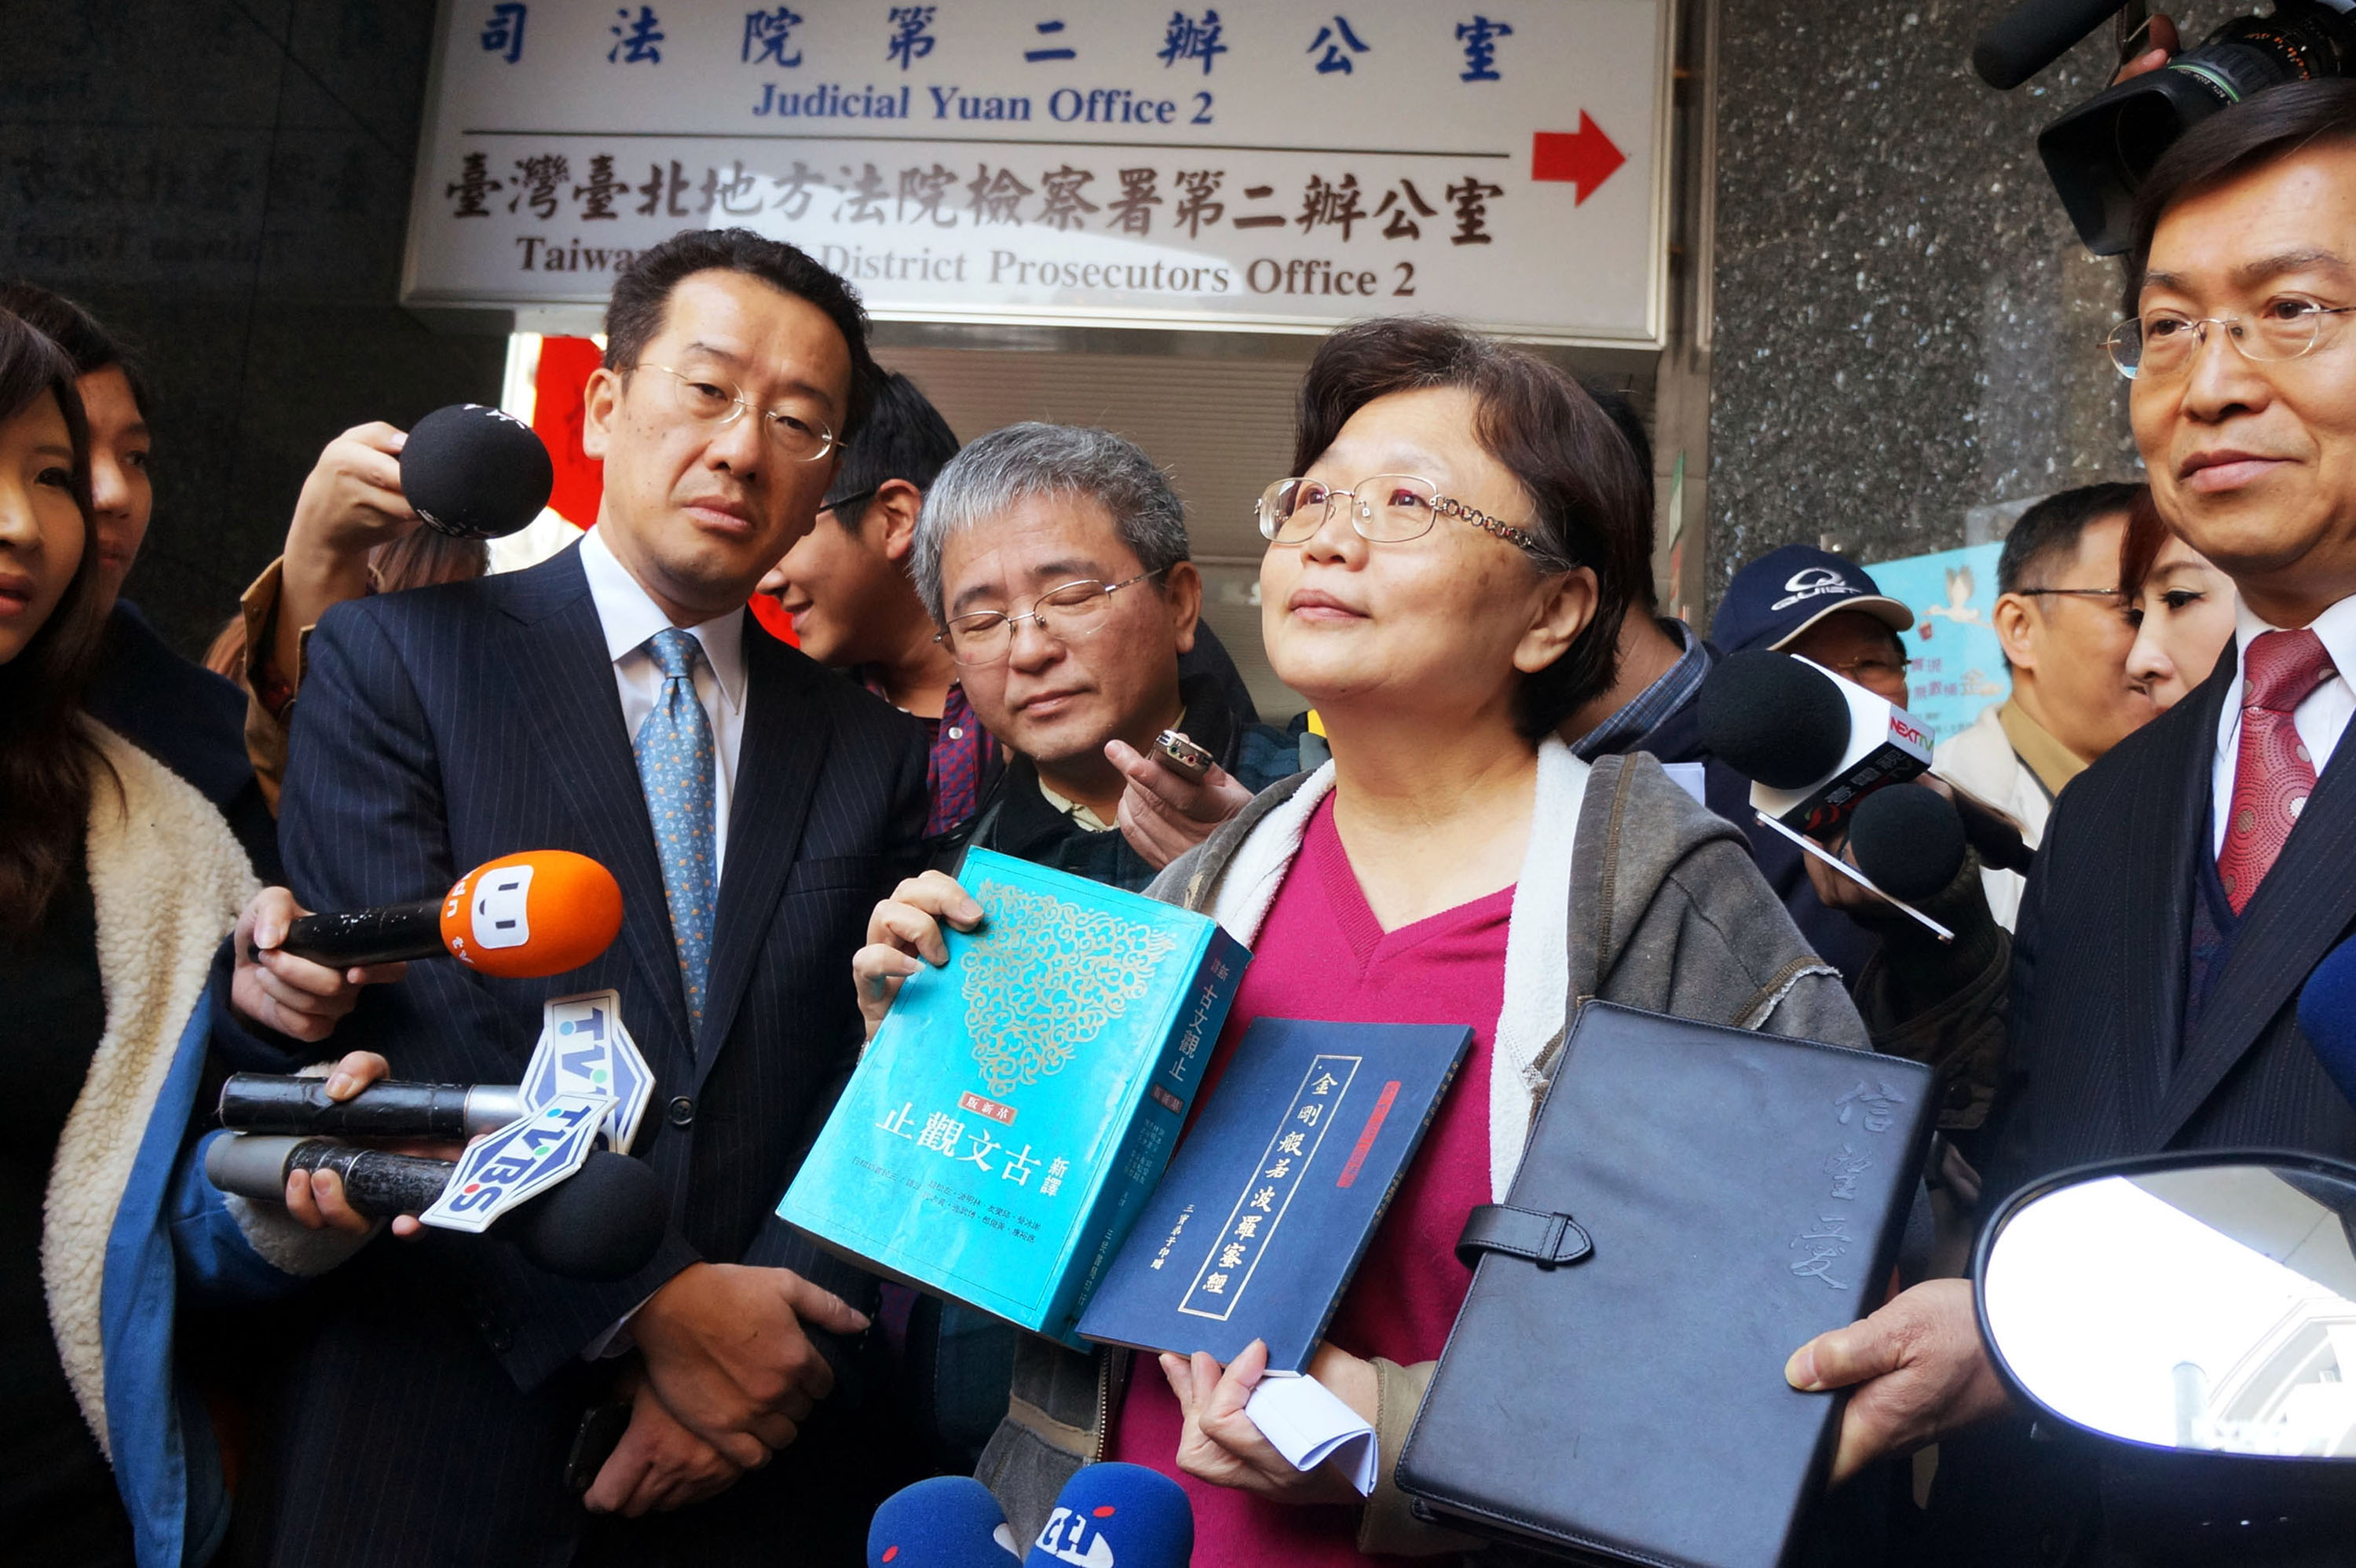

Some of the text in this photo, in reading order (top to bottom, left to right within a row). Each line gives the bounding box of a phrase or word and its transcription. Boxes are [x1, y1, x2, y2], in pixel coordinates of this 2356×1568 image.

[480, 2, 1513, 83] 司法院第二辦公室
[752, 82, 1213, 126] Judicial Yuan Office 2
[446, 153, 1504, 246] 臺灣臺北地方法院檢察署第二辦公室
[515, 237, 1417, 297] Taiwa District Prosecutors Office 2
[1169, 984, 1218, 1082] 古文觀止
[874, 1102, 1041, 1186] 古文觀止
[964, 1096, 1010, 1120] 革新版
[449, 1105, 592, 1213] TVBS
[1039, 1155, 1070, 1197] 新譯
[1202, 1072, 1338, 1295] 金剛般若波羅蜜經
